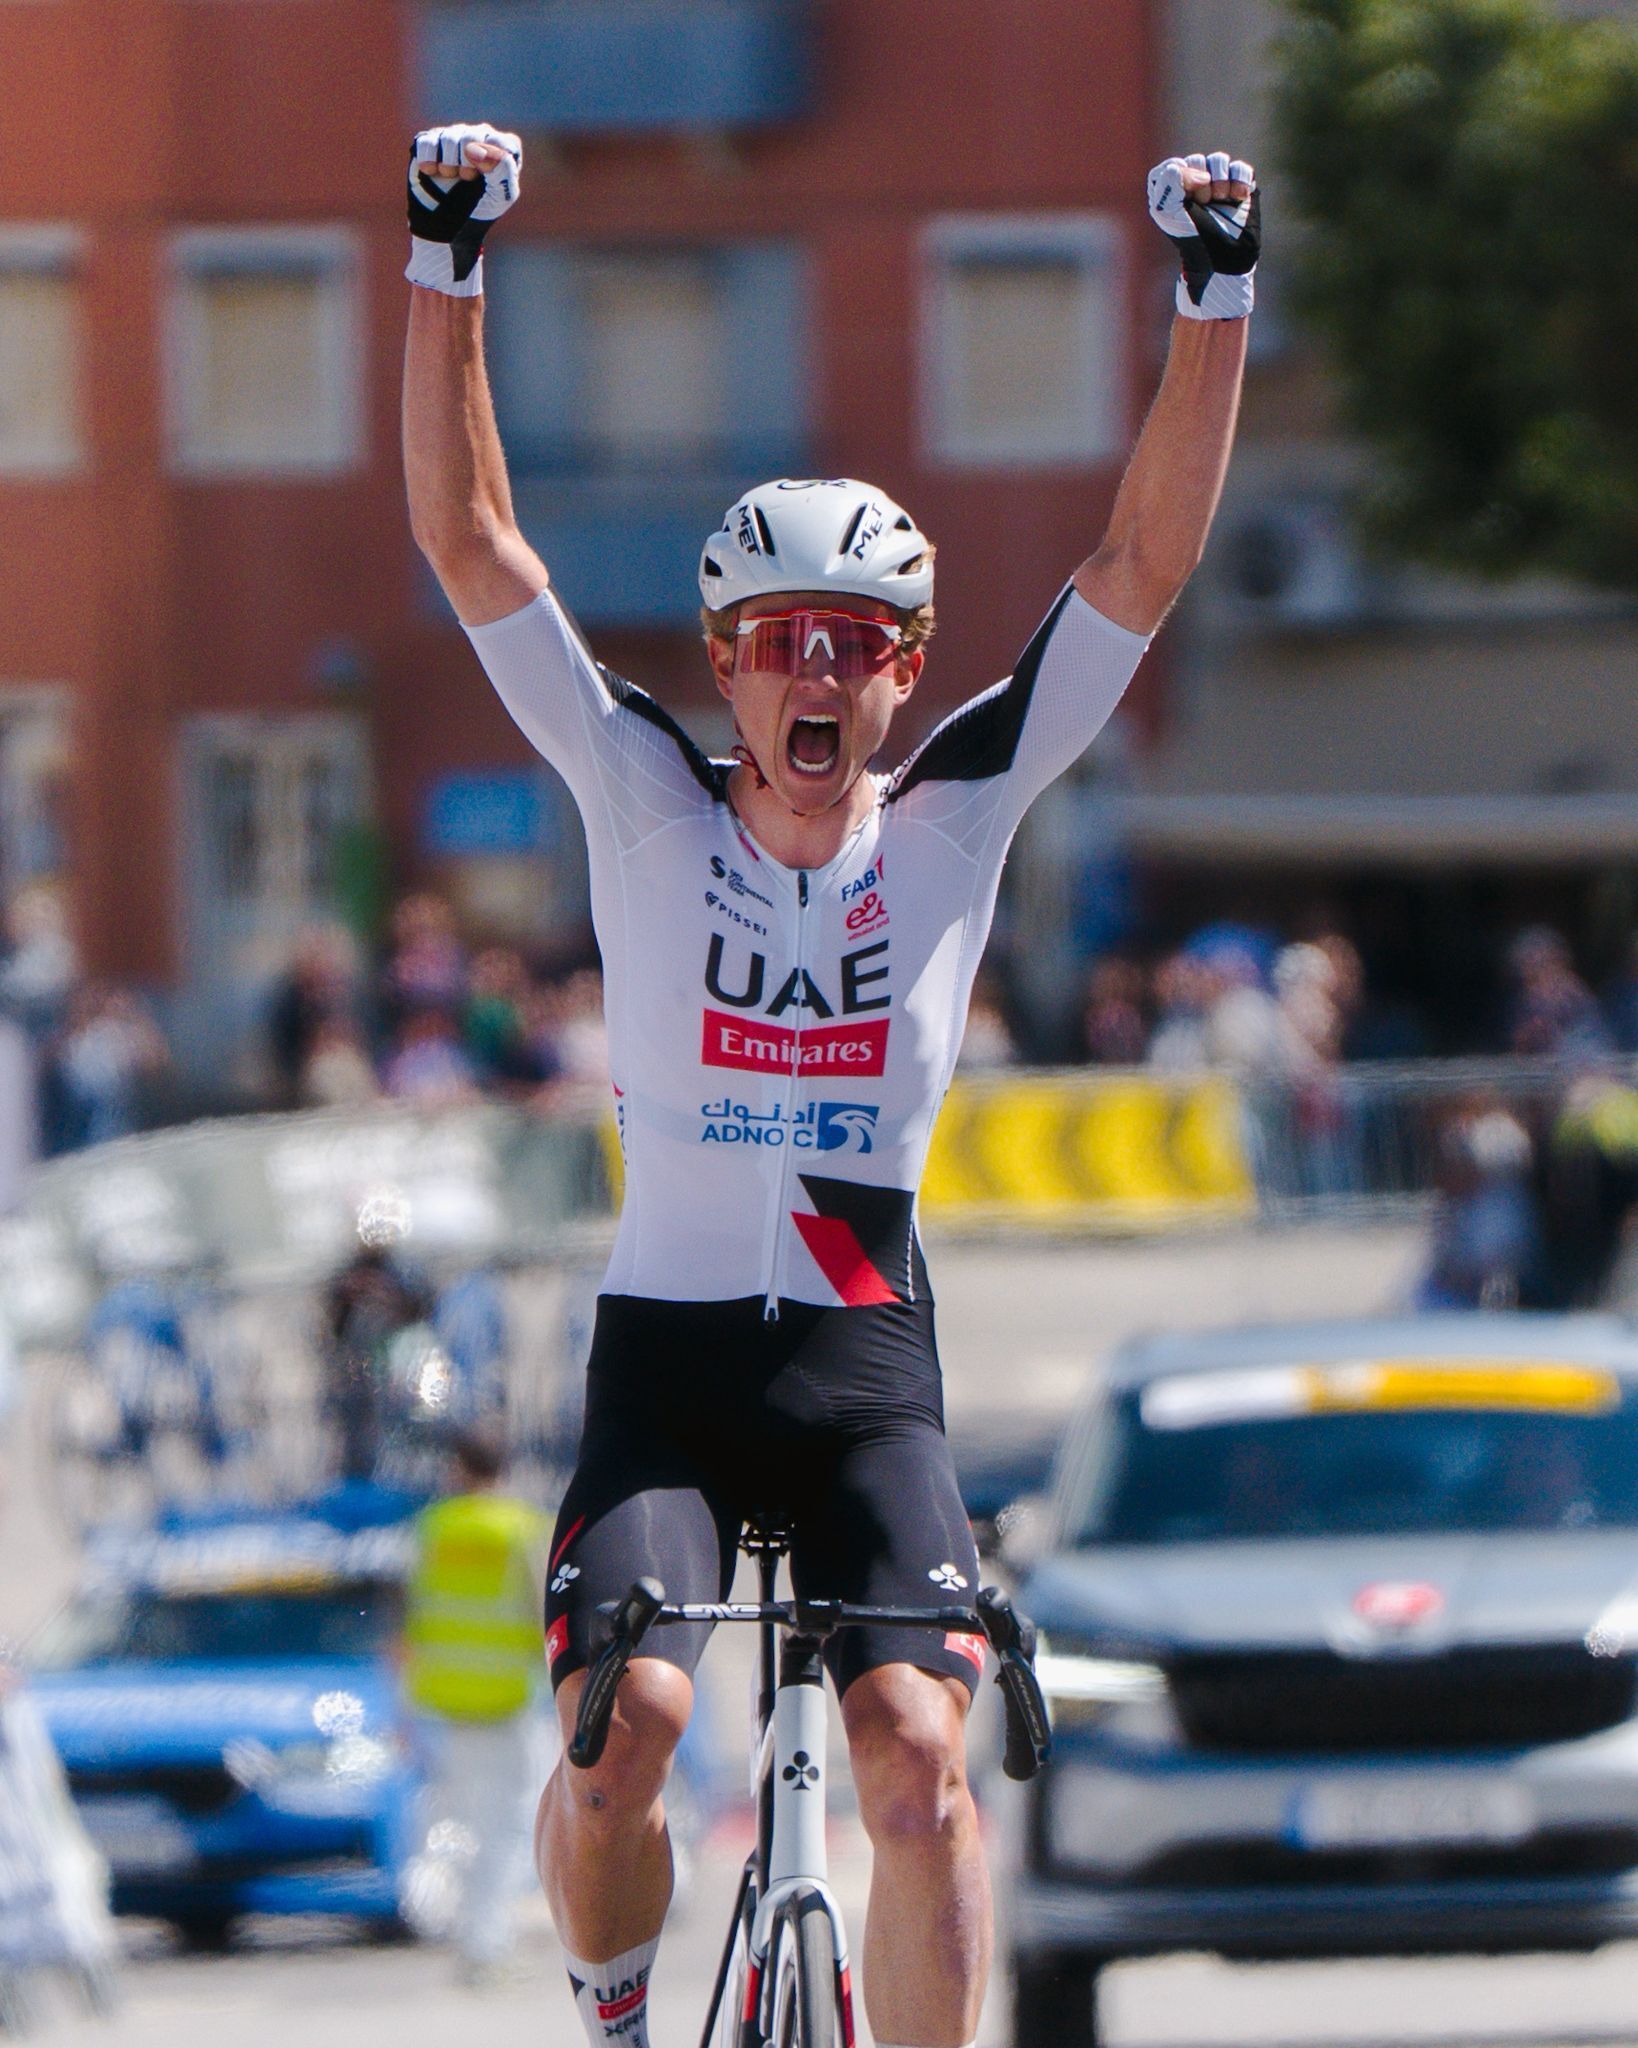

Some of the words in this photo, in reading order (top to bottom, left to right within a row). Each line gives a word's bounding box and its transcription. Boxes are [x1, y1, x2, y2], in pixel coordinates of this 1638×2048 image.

[738, 504, 761, 557] MET
[852, 502, 883, 561] MET
[719, 903, 767, 936] PISSEI
[704, 932, 892, 1019] UAE
[719, 1026, 873, 1065] Emirates
[701, 1123, 813, 1148] ADNOC
[595, 1965, 650, 2004] UAE
